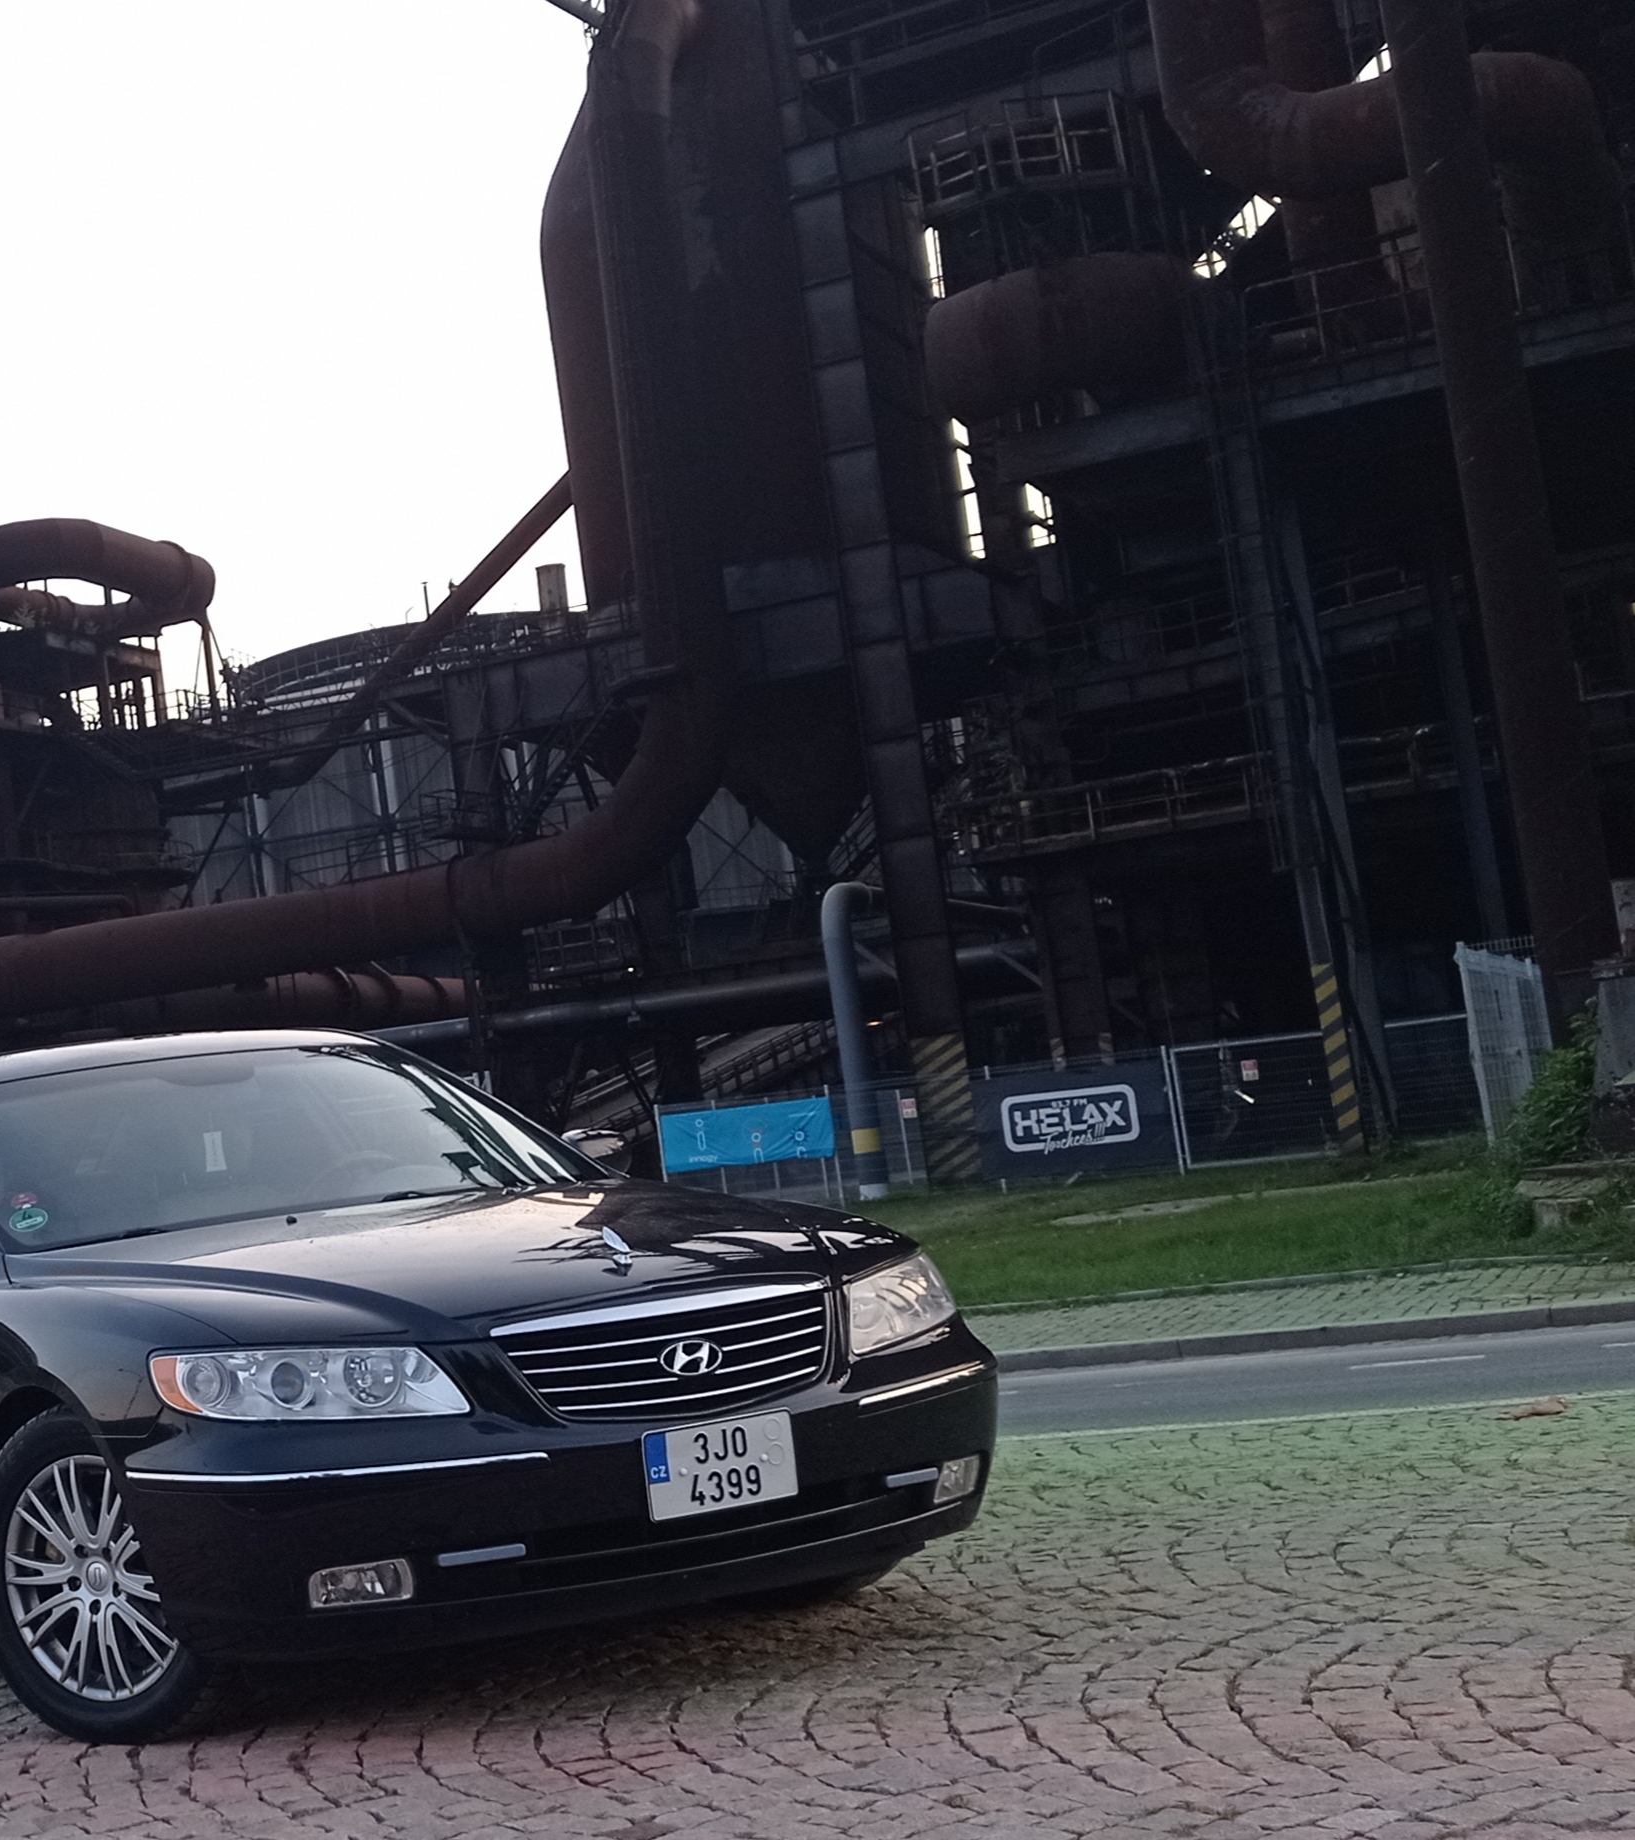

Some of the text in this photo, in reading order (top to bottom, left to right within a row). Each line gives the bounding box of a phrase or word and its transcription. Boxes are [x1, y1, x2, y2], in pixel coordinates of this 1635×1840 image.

[1073, 1098, 1088, 1107] FM
[1013, 1100, 1126, 1137] HELAX
[689, 1154, 718, 1164] innogy
[650, 1465, 667, 1479] CZ
[691, 1464, 762, 1506] 4399
